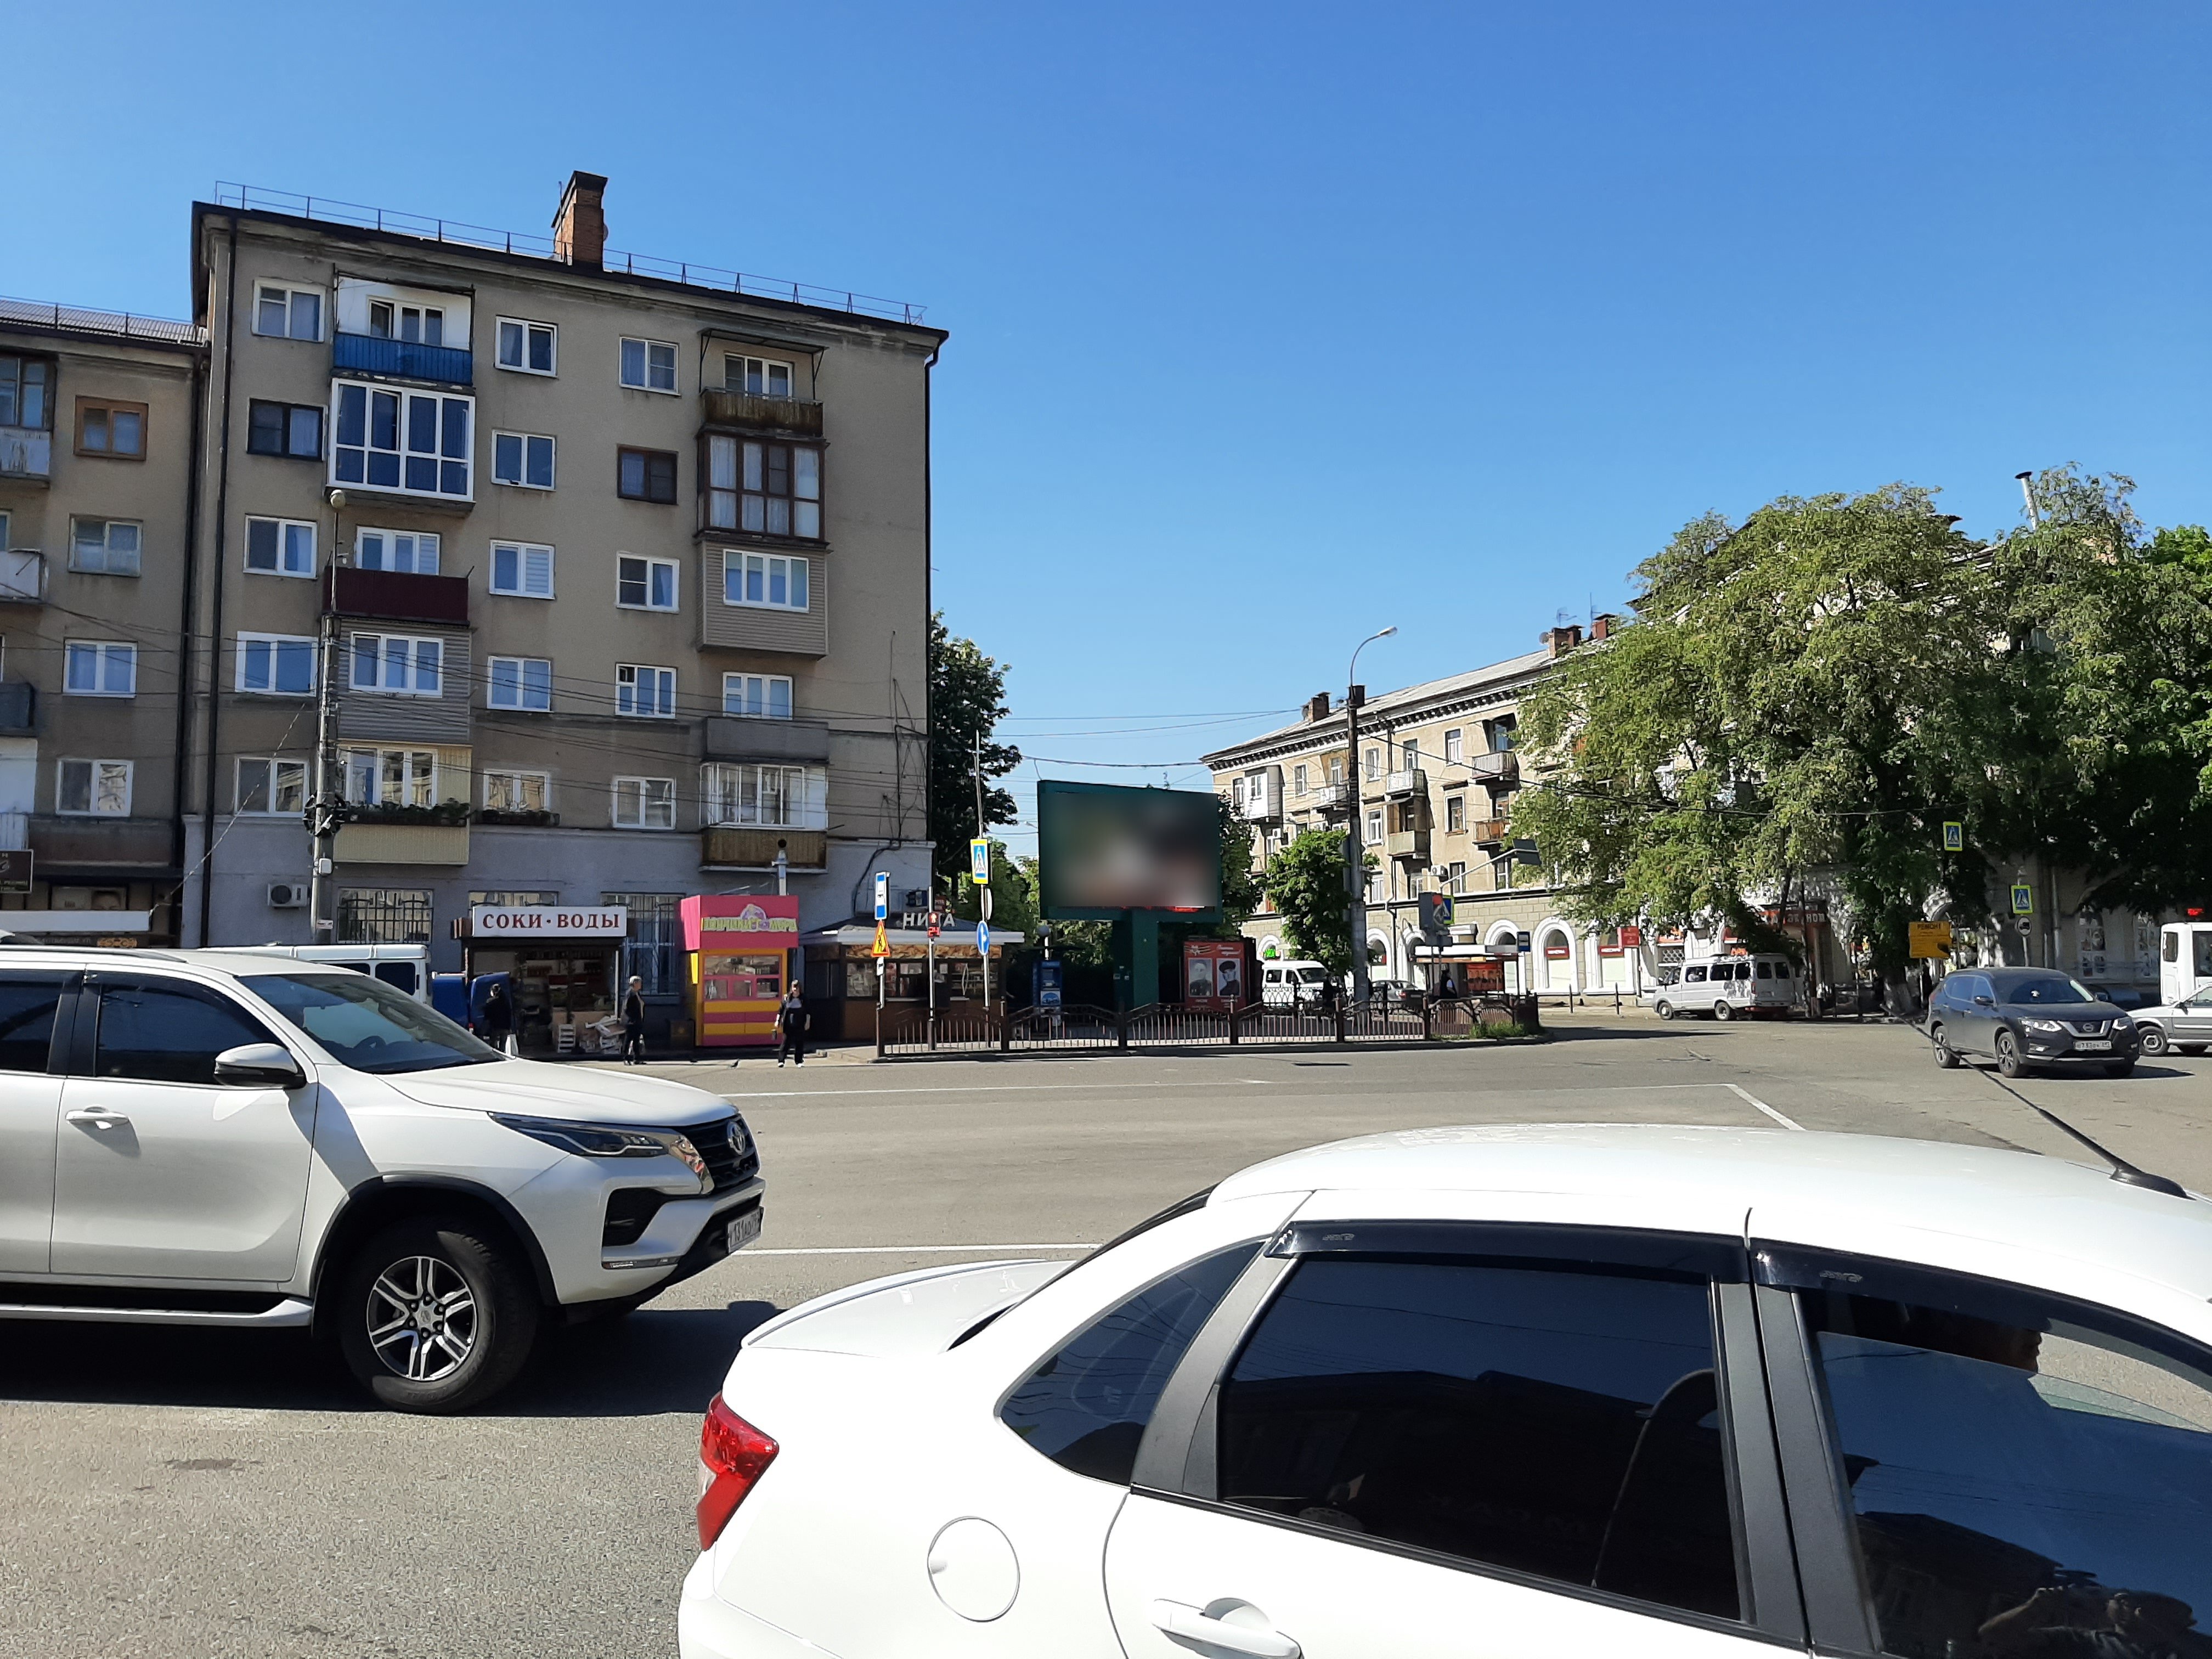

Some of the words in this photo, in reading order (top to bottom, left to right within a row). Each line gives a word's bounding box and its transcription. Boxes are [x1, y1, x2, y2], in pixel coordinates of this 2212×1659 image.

[483, 913, 542, 928] СОКИ
[557, 913, 619, 929] ВОДЫ
[902, 912, 955, 927] НИА
